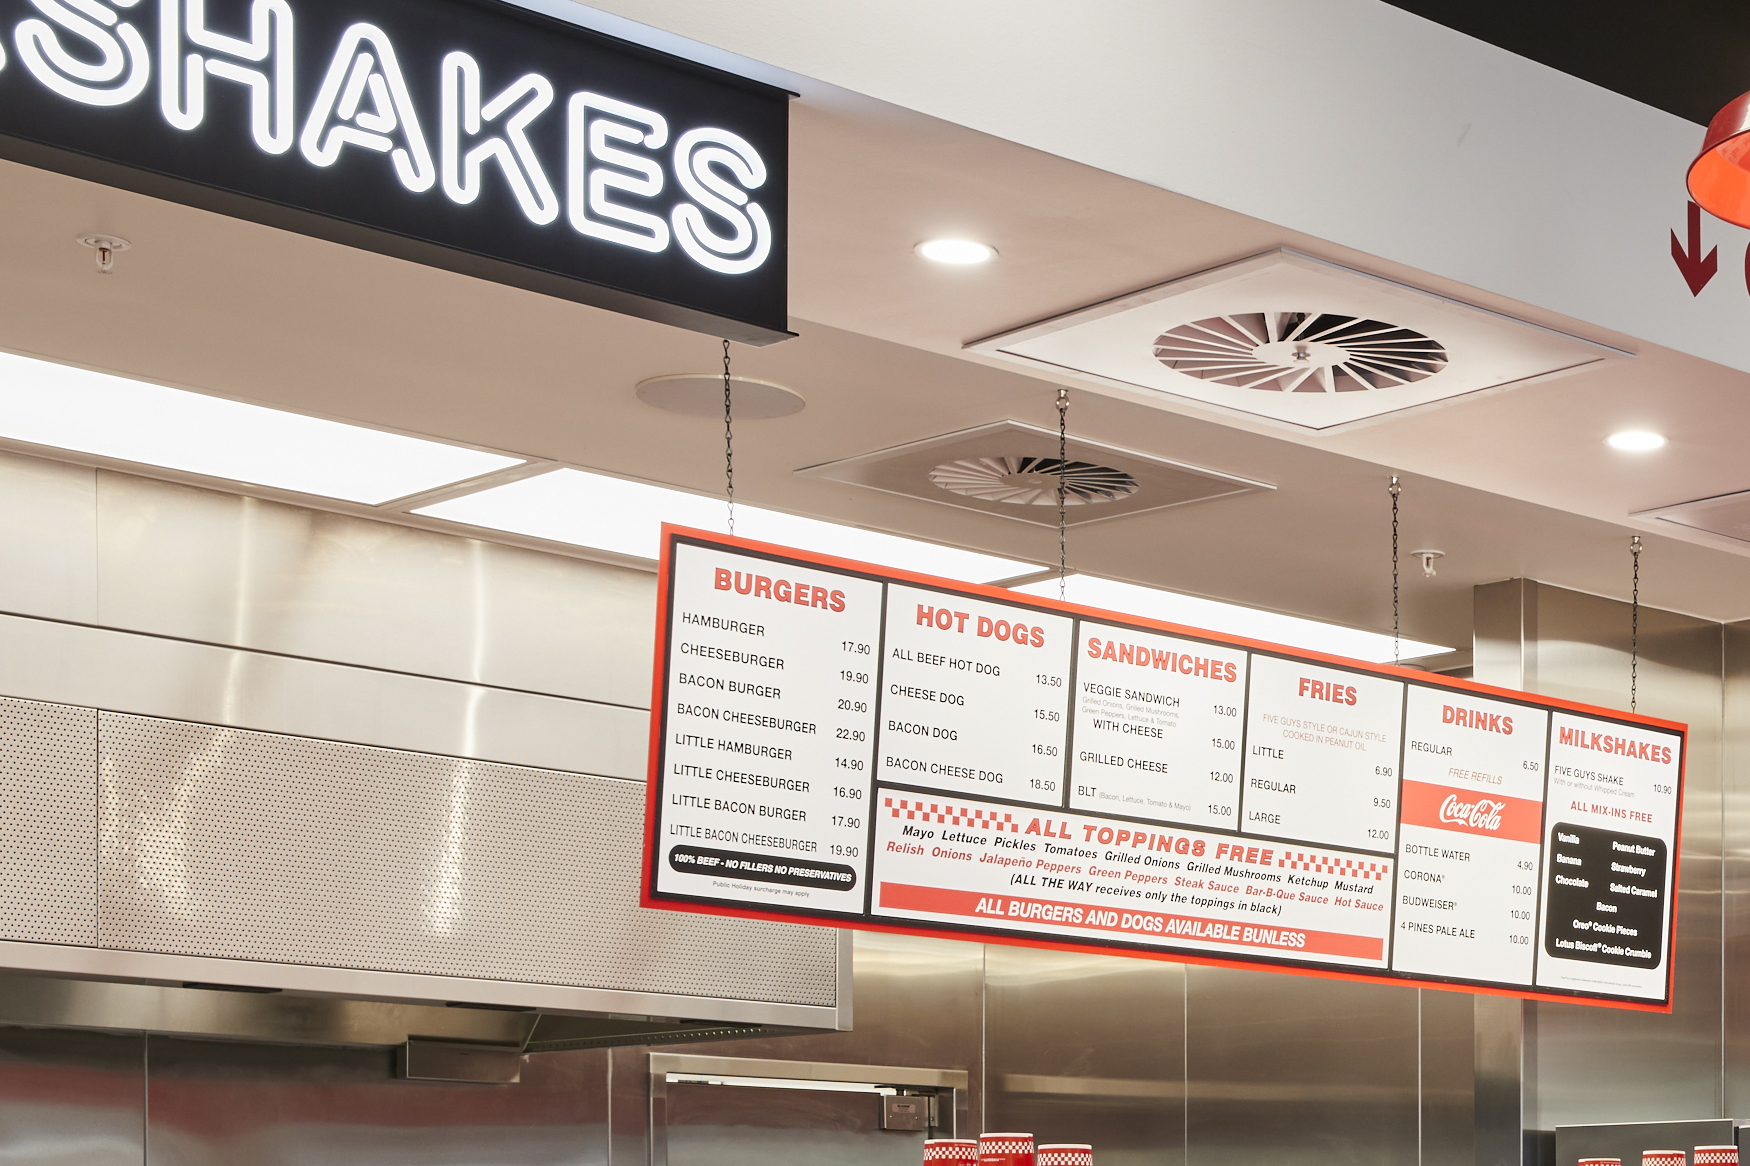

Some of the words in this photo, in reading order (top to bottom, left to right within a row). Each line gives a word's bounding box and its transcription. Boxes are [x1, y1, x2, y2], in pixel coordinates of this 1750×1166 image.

[0, 0, 772, 275] SHAKES
[713, 567, 845, 612] BURGERS
[681, 612, 765, 636] HAMBURGER
[841, 641, 870, 655] 17.90
[915, 604, 969, 633] HOT
[976, 616, 1044, 648] DOGS
[680, 642, 784, 670] CHEESEBURGER
[839, 670, 869, 684] 19.90
[891, 648, 913, 661] ALL
[916, 652, 946, 666] BEEF
[948, 658, 973, 671] HOT
[975, 663, 1000, 676] DOG
[1035, 674, 1062, 688] 13.50
[1087, 638, 1236, 683] SANDWICHES
[678, 673, 724, 690] BACON
[728, 681, 781, 699] BURGER
[837, 699, 867, 713] 20.90
[889, 684, 936, 701] CHEESE
[939, 692, 964, 706] DOG
[1033, 709, 1060, 722] 15.50
[1082, 682, 1121, 698] VEGGIE
[1123, 689, 1180, 707] SANDWICH
[1213, 705, 1237, 717] 13.00
[1298, 677, 1357, 706] FRIES
[676, 703, 719, 719] BACON
[722, 710, 816, 734] CHEESEBURGER
[835, 728, 865, 742] 22.90
[1441, 705, 1513, 735] DRINKS
[674, 733, 714, 749] LITTLE
[717, 740, 792, 760] HAMBURGER
[834, 757, 864, 771] 14.90
[1252, 746, 1284, 760] LITTLE
[1374, 766, 1392, 777] 6.90
[1410, 740, 1452, 756] REGULAR
[1522, 760, 1539, 771] 6.50
[1558, 727, 1671, 764] MILKSHAKES
[1079, 751, 1124, 767] GRILLED
[1126, 758, 1168, 773] CHEESE
[1209, 771, 1233, 783] 12.00
[1554, 765, 1571, 776] FIVE
[1573, 768, 1595, 781] GUYS
[1596, 773, 1624, 786] SHAKE
[1653, 784, 1671, 795] 10.90
[1077, 785, 1097, 797] BLT
[1207, 804, 1231, 816] 15.00
[1250, 778, 1296, 794] REGULAR
[1372, 797, 1391, 809] 9.50
[1439, 793, 1505, 831] Coca-Cola
[1569, 801, 1588, 812] ALL
[1590, 804, 1626, 819] MIX-INS
[1628, 811, 1652, 823] FREE
[1024, 818, 1072, 840] ALL
[1082, 825, 1206, 857] TOPPINGS
[1214, 843, 1274, 866] FREE
[1248, 811, 1281, 825] LARGE
[1367, 829, 1389, 840] 12.00
[901, 825, 934, 840] Mayo
[941, 830, 987, 845] Lettuce
[993, 837, 1036, 851] Pickles
[1044, 843, 1097, 859] Tomatoes
[1104, 851, 1141, 864] Grilled
[1143, 856, 1180, 869] Onions
[1186, 861, 1222, 874] Grilled
[1223, 866, 1281, 882] Mushrooms
[1286, 874, 1329, 890] Ketchup
[1333, 880, 1374, 894] Mustard
[1404, 844, 1439, 857] BOTTLE
[1441, 849, 1470, 861] WATER
[1516, 861, 1533, 871] 4.90
[974, 898, 1004, 915] ALL
[1007, 901, 1083, 923] BURGERS
[1084, 910, 1118, 927] AND
[1119, 913, 1163, 932] DOGS
[1163, 919, 1241, 941] AVAILABLE
[1241, 927, 1306, 948] BUNLESS
